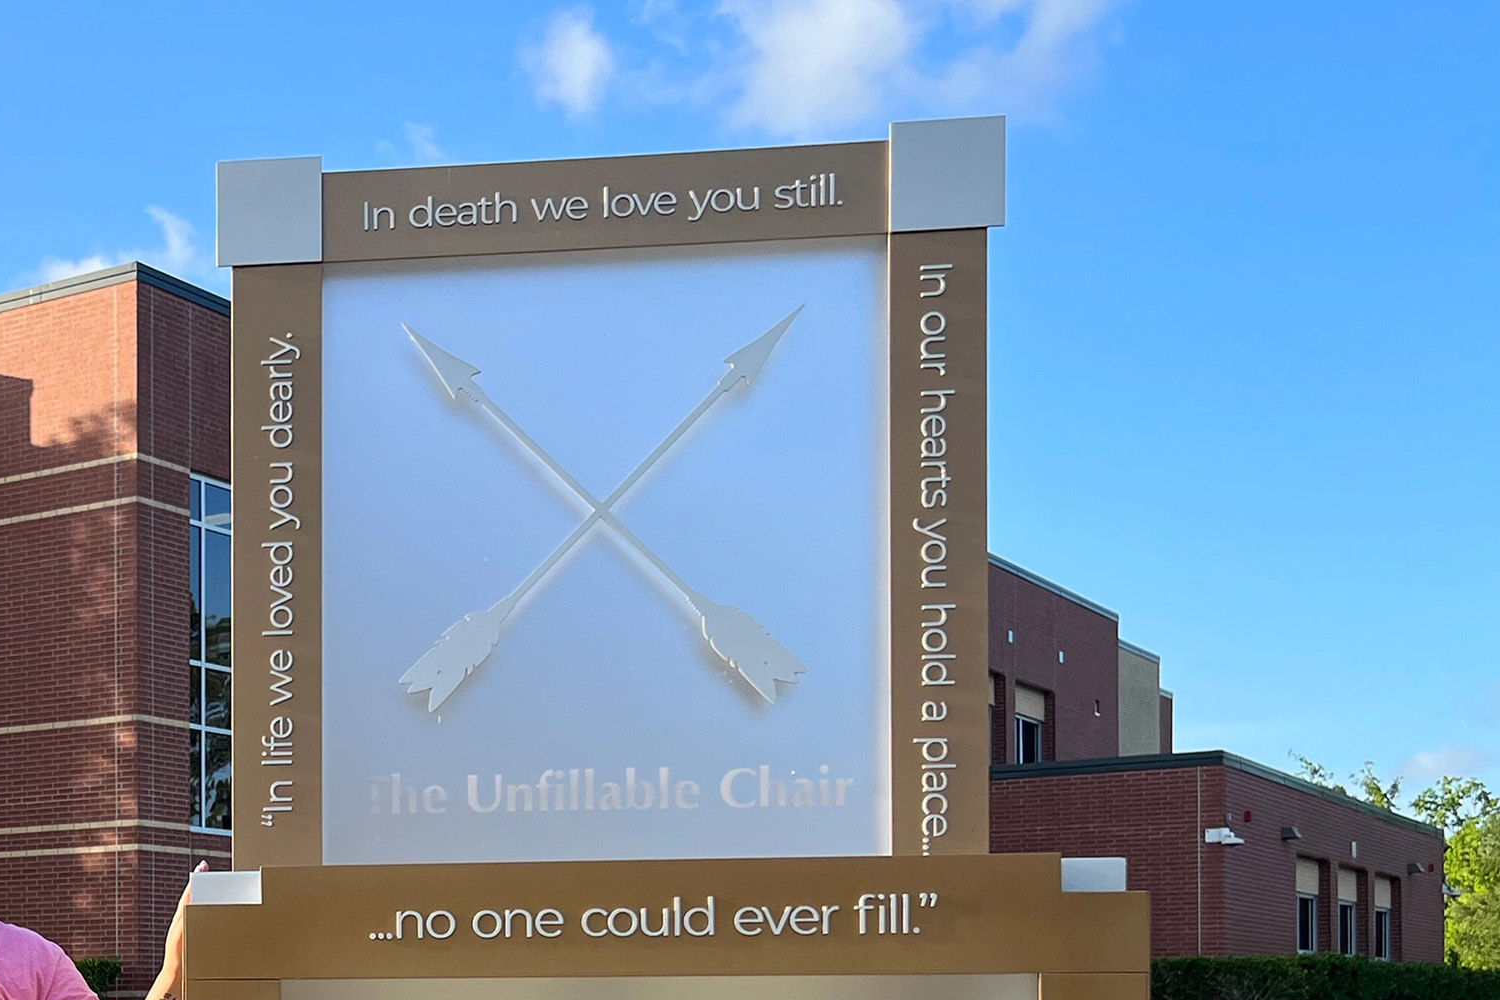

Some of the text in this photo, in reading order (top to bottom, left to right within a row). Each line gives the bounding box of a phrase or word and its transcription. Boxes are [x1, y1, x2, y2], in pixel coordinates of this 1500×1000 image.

[363, 173, 844, 230] In death we love you still.
[261, 331, 301, 450] dearly.
[269, 460, 301, 532] you
[261, 540, 294, 637] loved
[912, 262, 957, 858] In our hearts you hold a place...
[269, 648, 294, 707] we
[260, 715, 294, 768] life
[466, 767, 700, 814] Unfillable
[719, 763, 855, 810] Chair
[368, 908, 457, 941] ...no
[471, 906, 566, 940] one
[580, 895, 715, 938] could
[732, 903, 839, 937] ever
